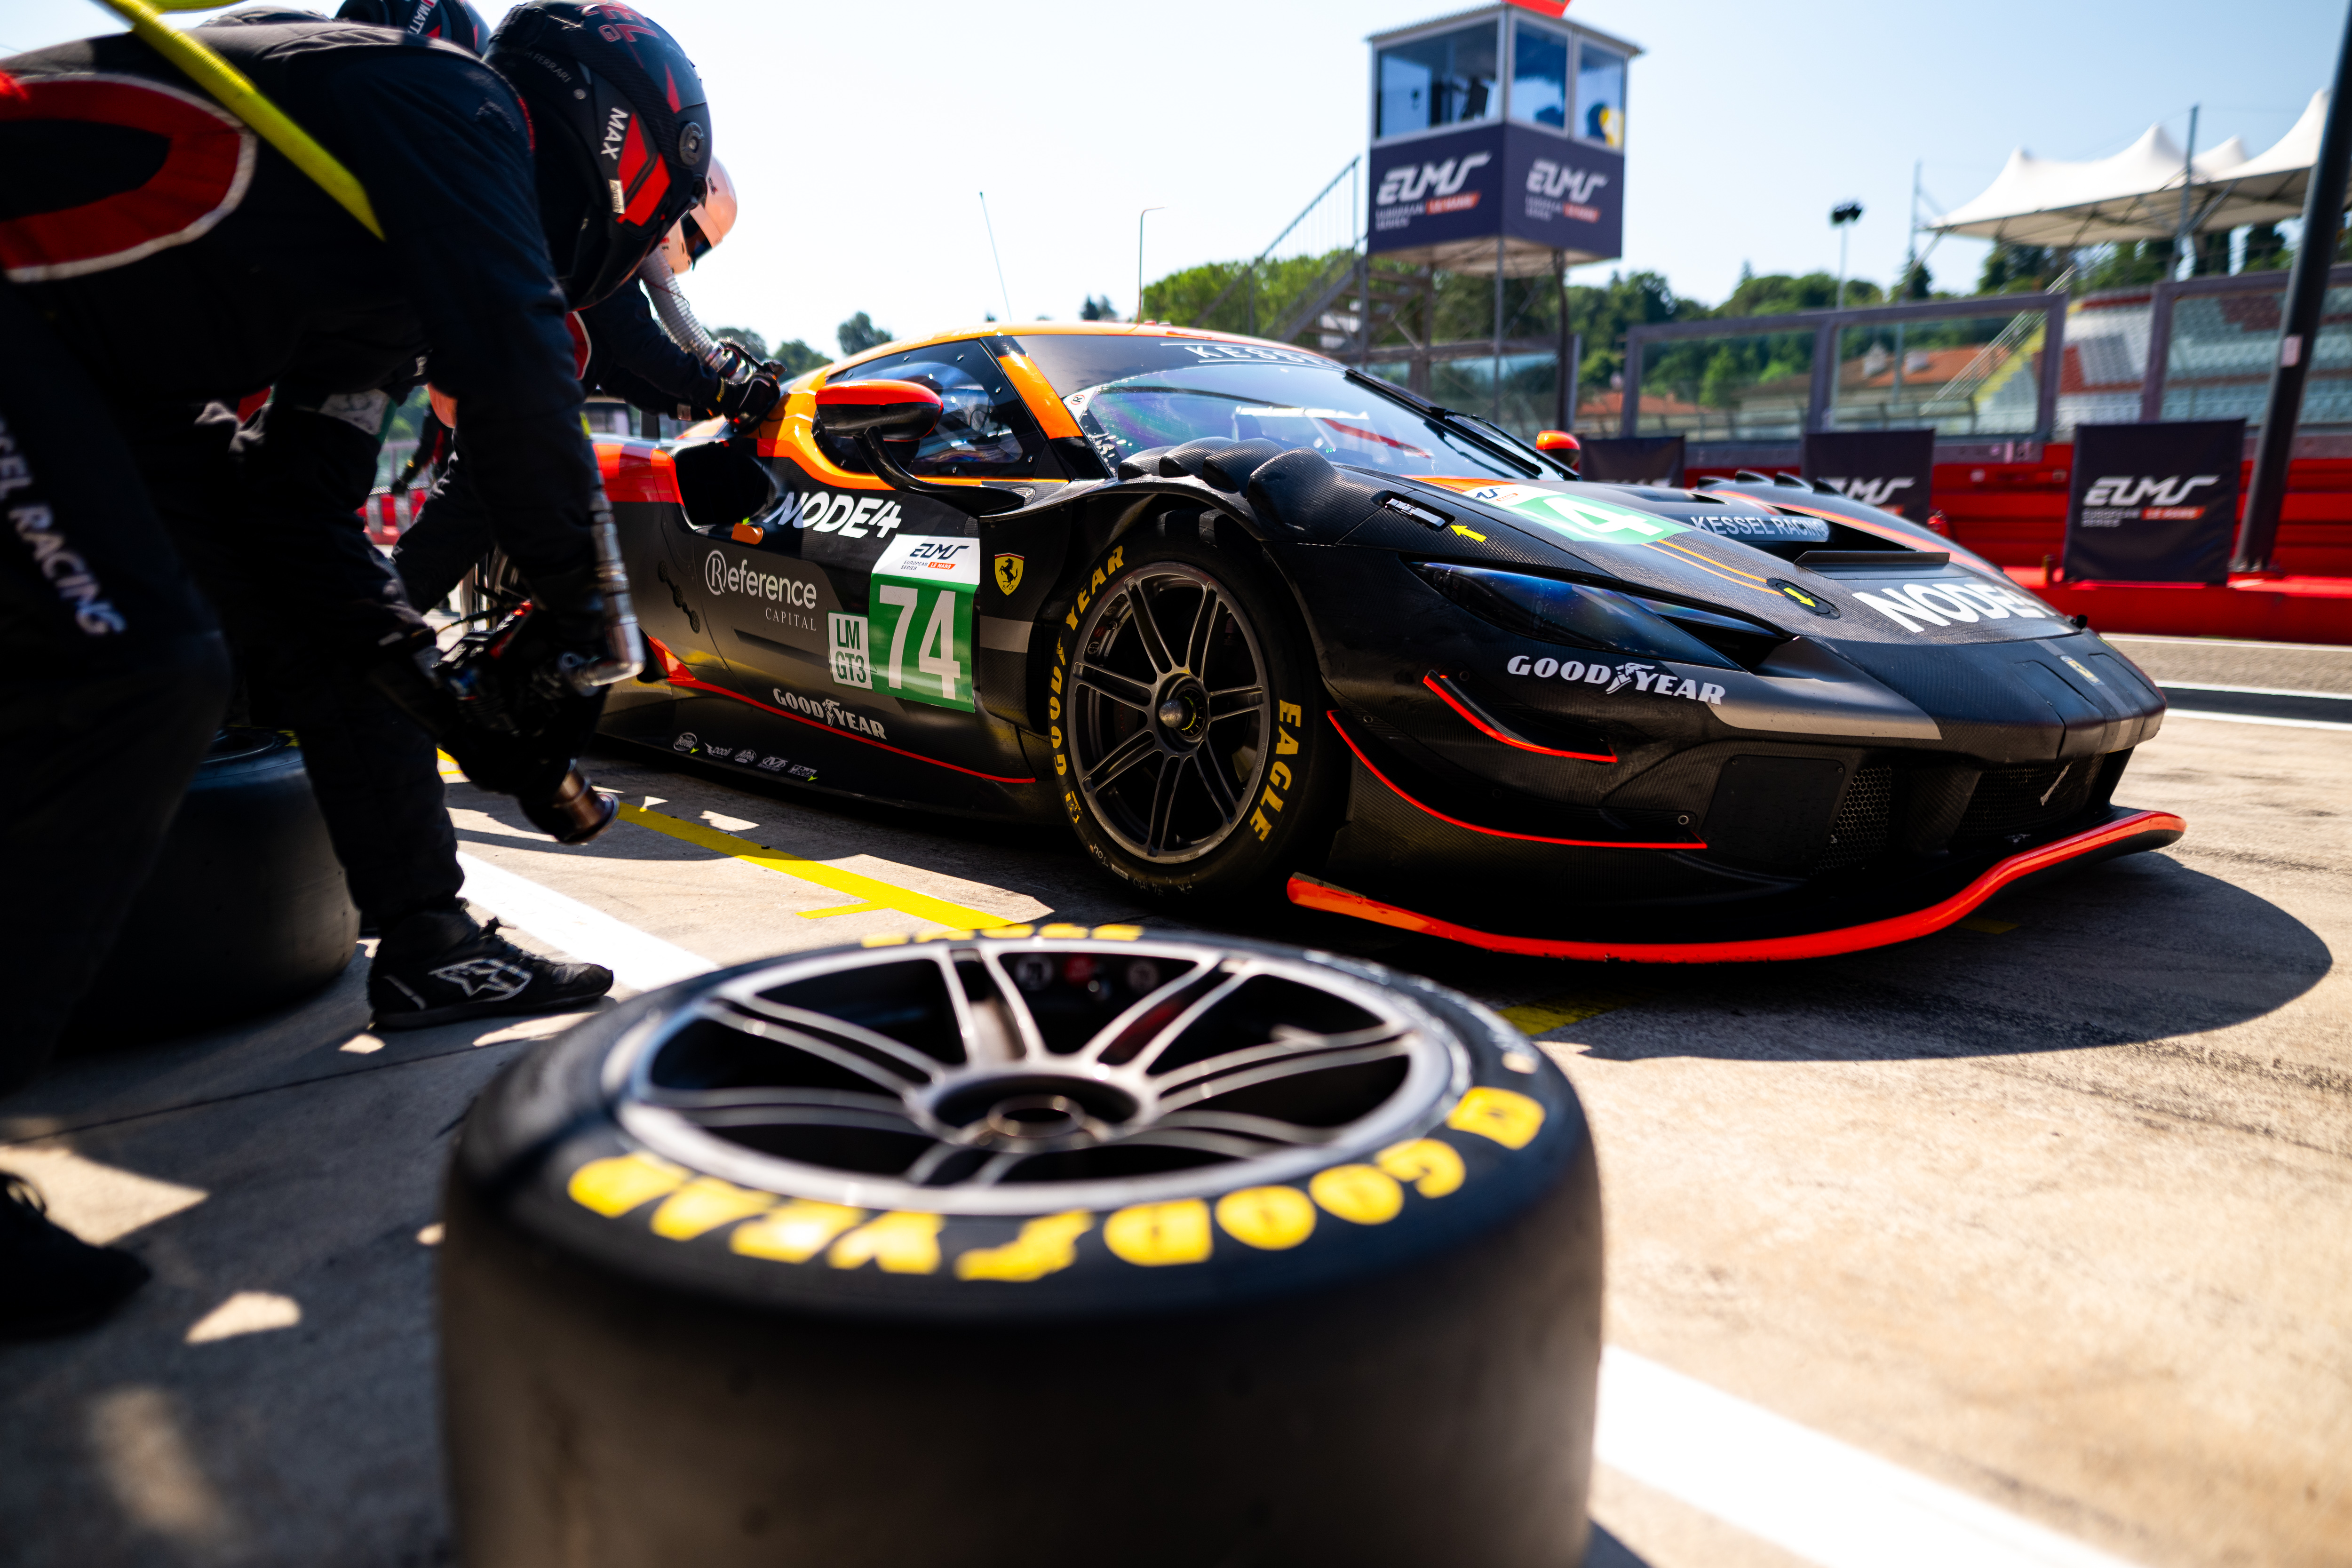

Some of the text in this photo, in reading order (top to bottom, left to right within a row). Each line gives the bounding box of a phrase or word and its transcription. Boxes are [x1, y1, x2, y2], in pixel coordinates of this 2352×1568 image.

[600, 107, 628, 160] MAX
[1376, 150, 1493, 206] ELMS
[1526, 158, 1609, 204] ELMS
[2083, 475, 2220, 507] ELMS
[763, 491, 902, 539] NODE4
[1690, 516, 1829, 538] KESSEL RACING
[7, 500, 129, 637] RACING
[909, 543, 970, 560] ELMS
[705, 549, 817, 610] Reference
[765, 608, 817, 631] CAPITAL
[836, 618, 860, 650] LM
[879, 584, 961, 701] 74
[835, 650, 867, 684] GT3
[1249, 698, 1302, 842] EAGLE
